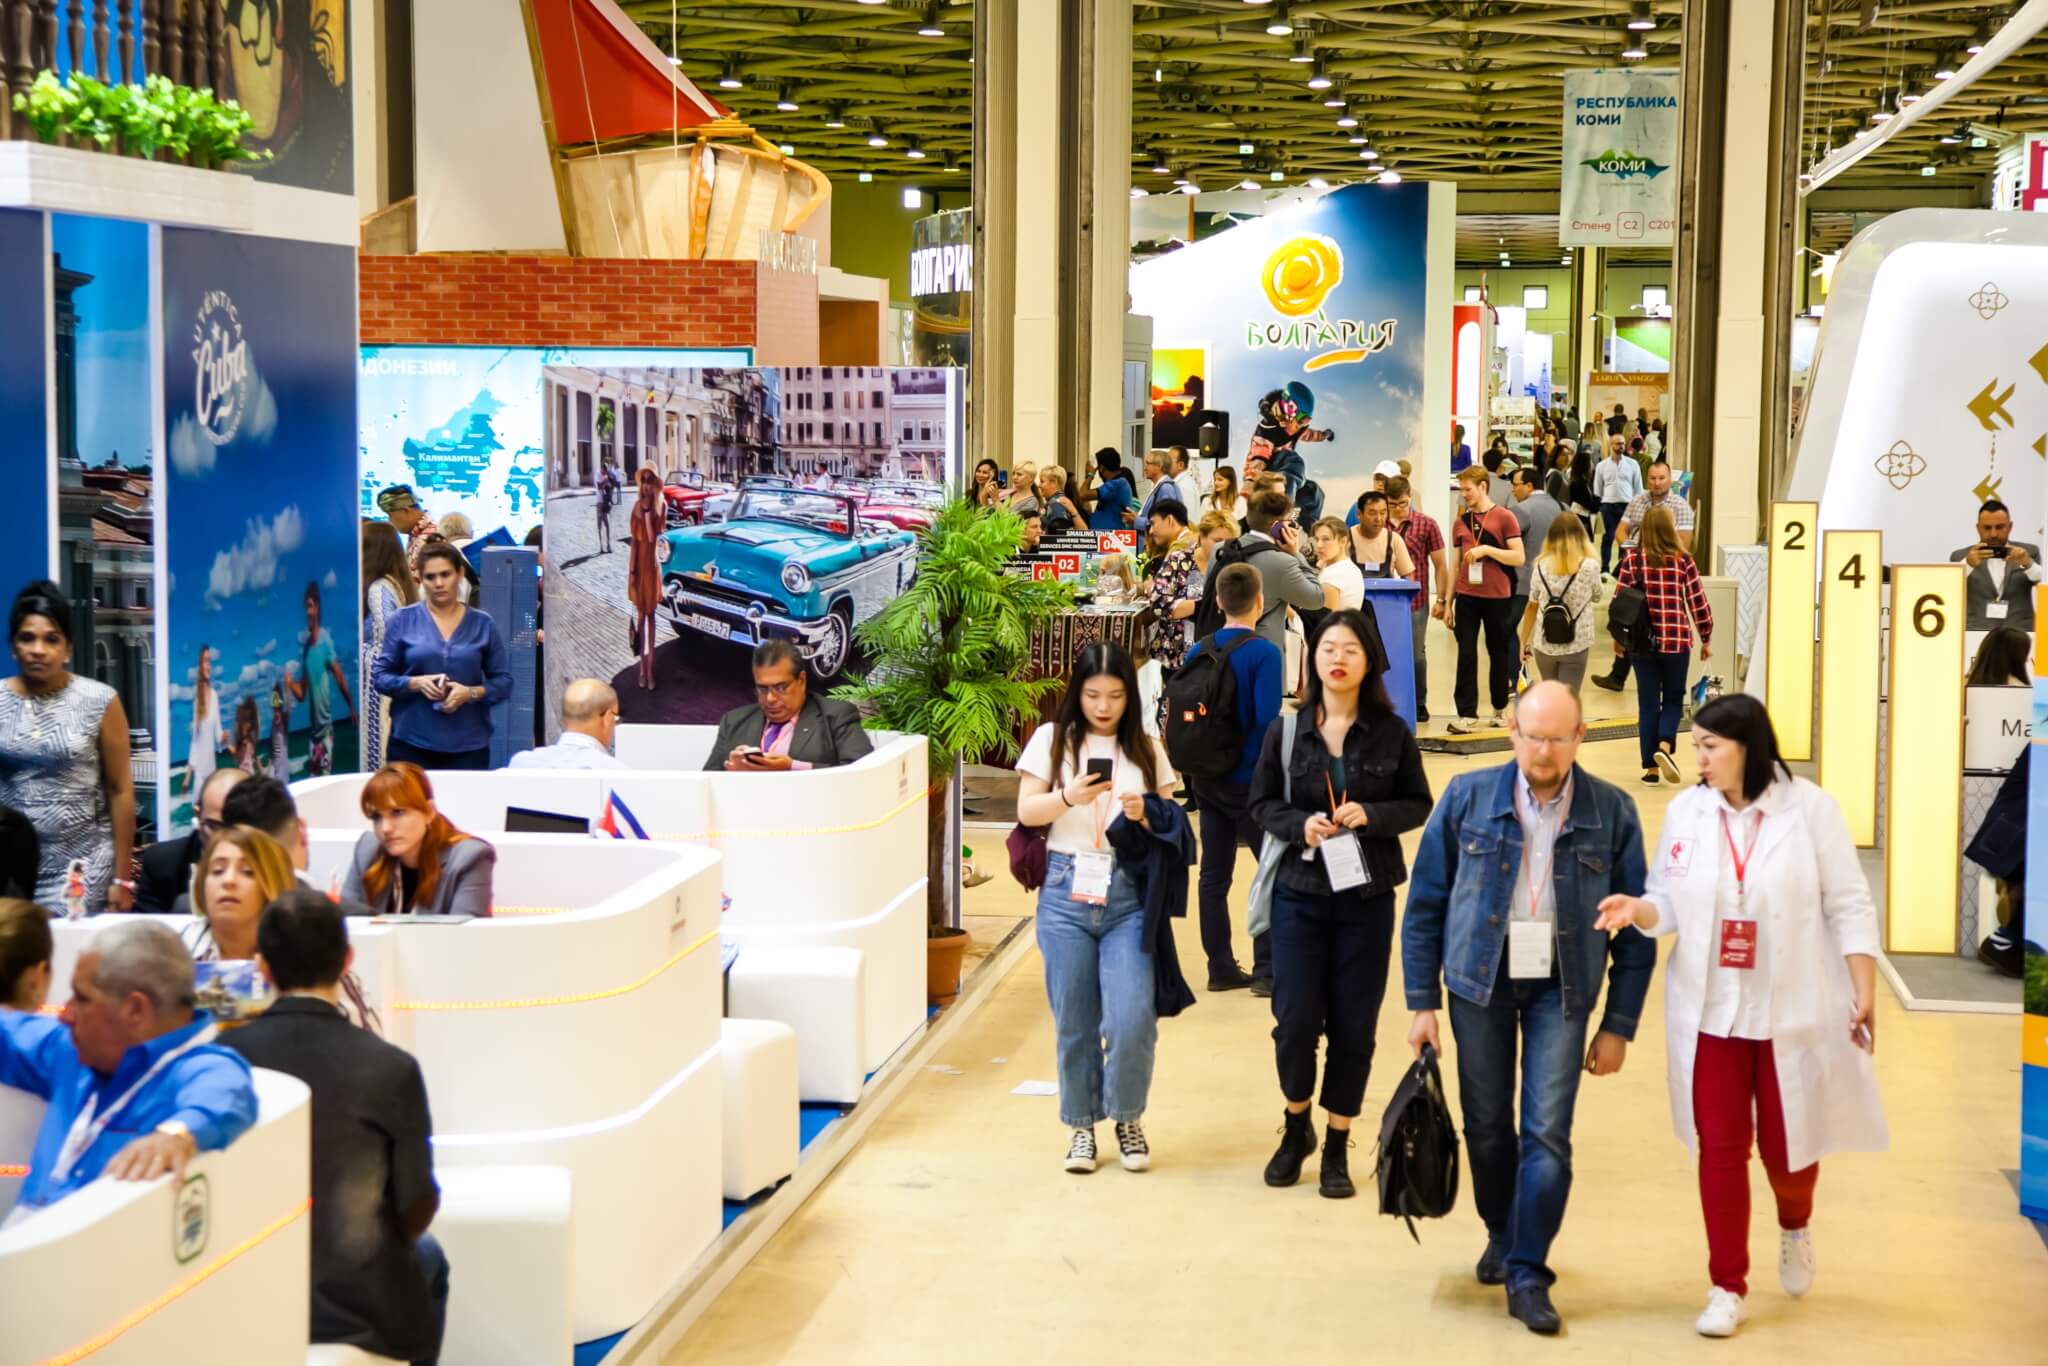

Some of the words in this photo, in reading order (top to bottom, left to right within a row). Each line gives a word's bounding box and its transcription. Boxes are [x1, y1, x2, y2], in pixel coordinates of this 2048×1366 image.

[1576, 96, 1677, 109] РЕСПУБЛИКА
[1576, 114, 1621, 126] КОМИ
[1599, 160, 1646, 172] КОМИ
[1246, 319, 1398, 352] БОЛГАРИЯ
[196, 328, 247, 427] Cuba
[418, 452, 481, 463] Калимантан
[1783, 521, 1806, 551] 2
[1058, 558, 1074, 570] 02
[1838, 553, 1866, 589] 4
[1912, 594, 1945, 638] 6
